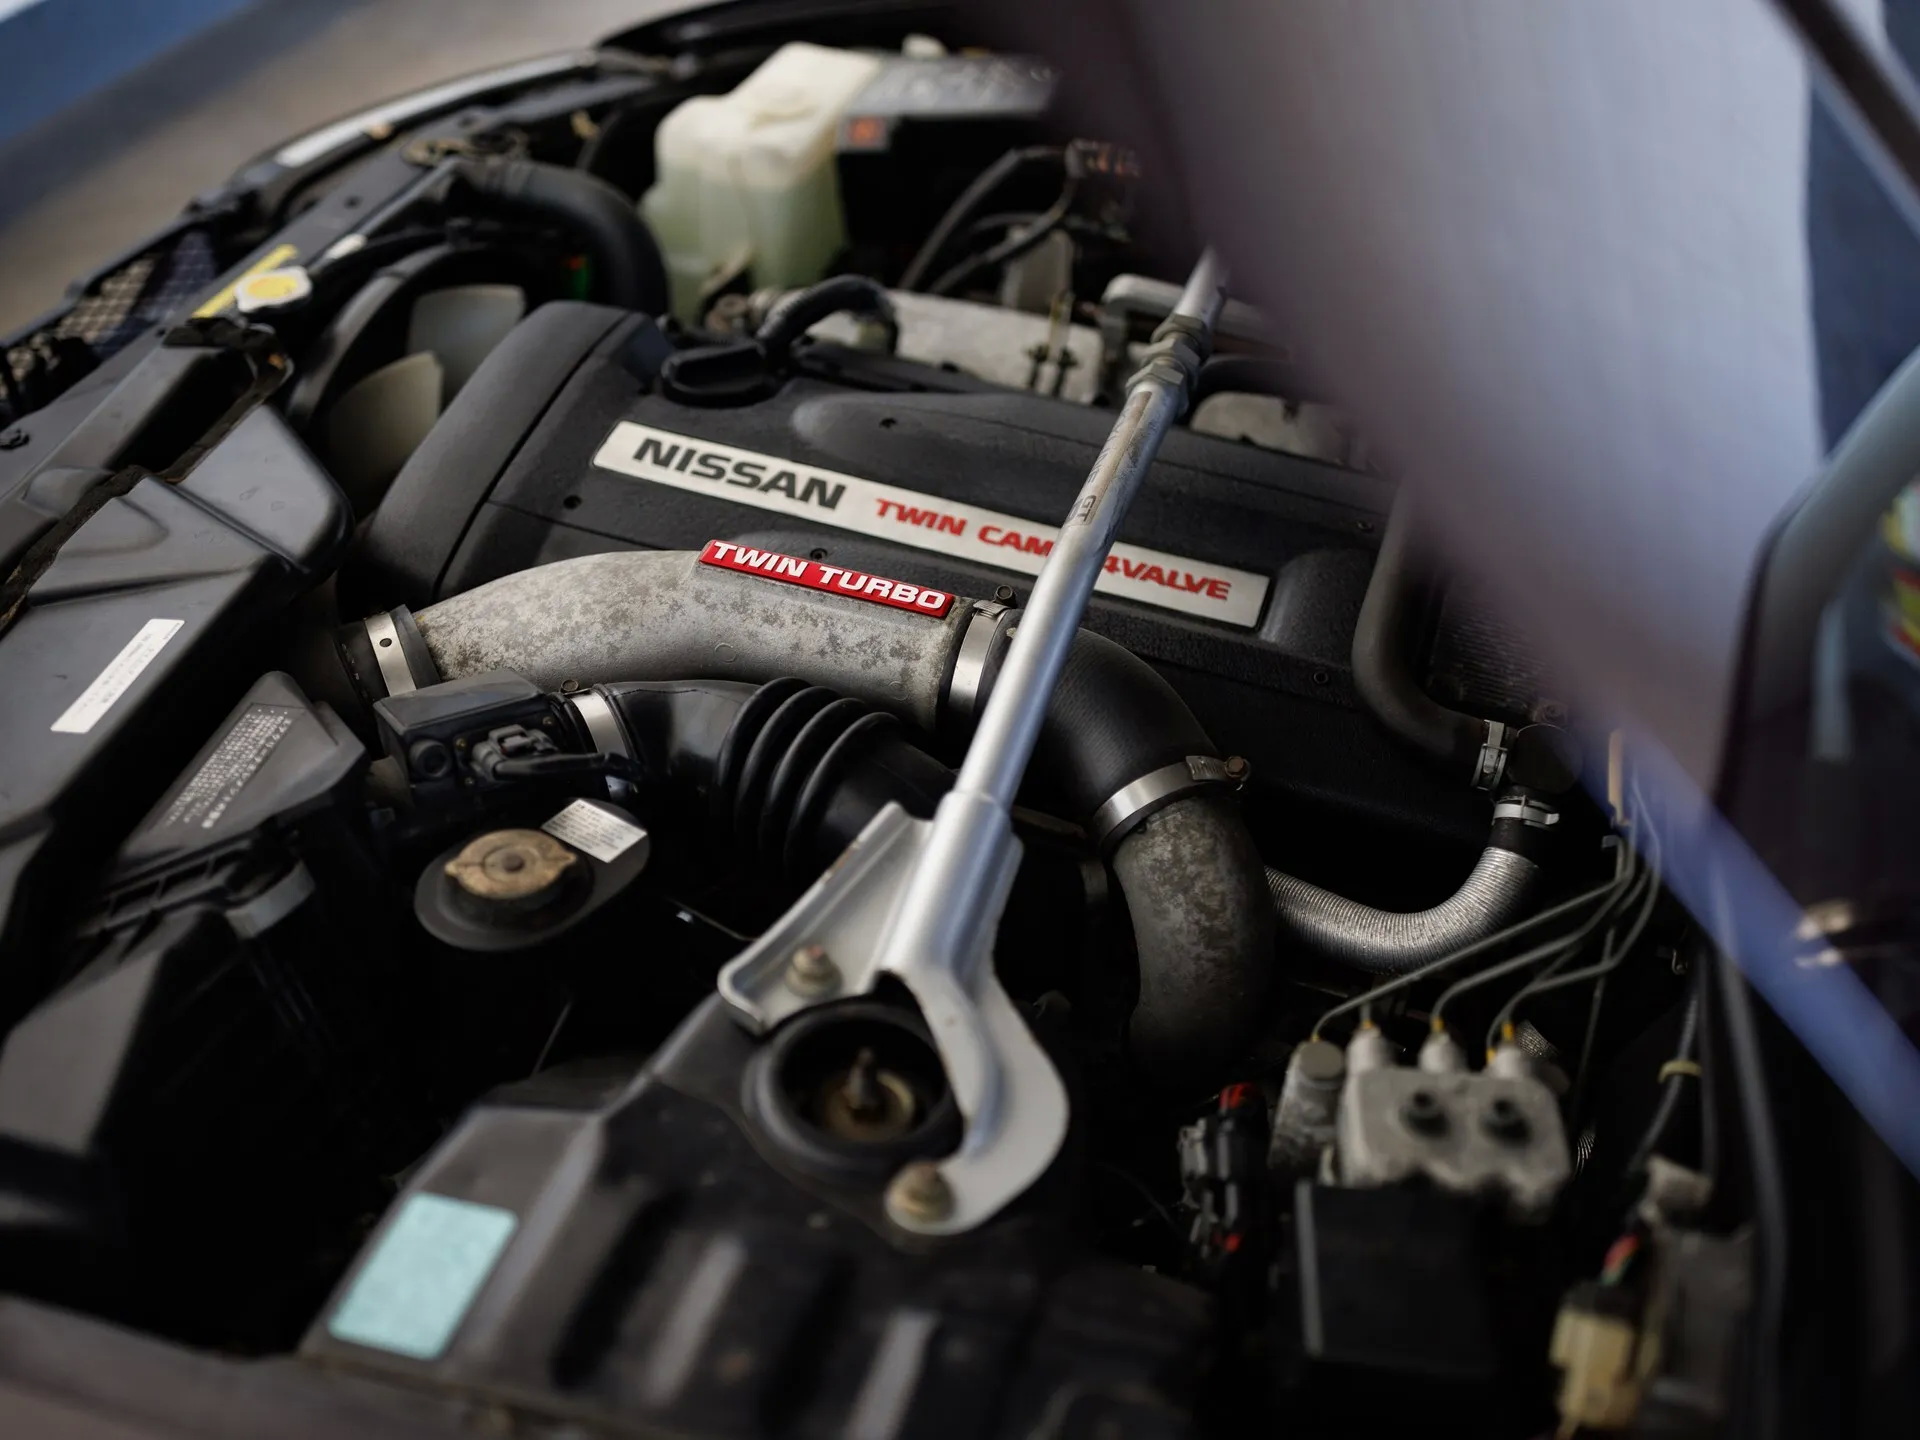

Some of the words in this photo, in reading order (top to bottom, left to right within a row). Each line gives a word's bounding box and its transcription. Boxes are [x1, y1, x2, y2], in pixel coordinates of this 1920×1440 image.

[633, 438, 846, 509] NISSAN
[876, 498, 967, 537] TWIN
[977, 525, 1055, 557] CAM
[714, 541, 809, 577] TWIN
[819, 566, 946, 609] TURBO
